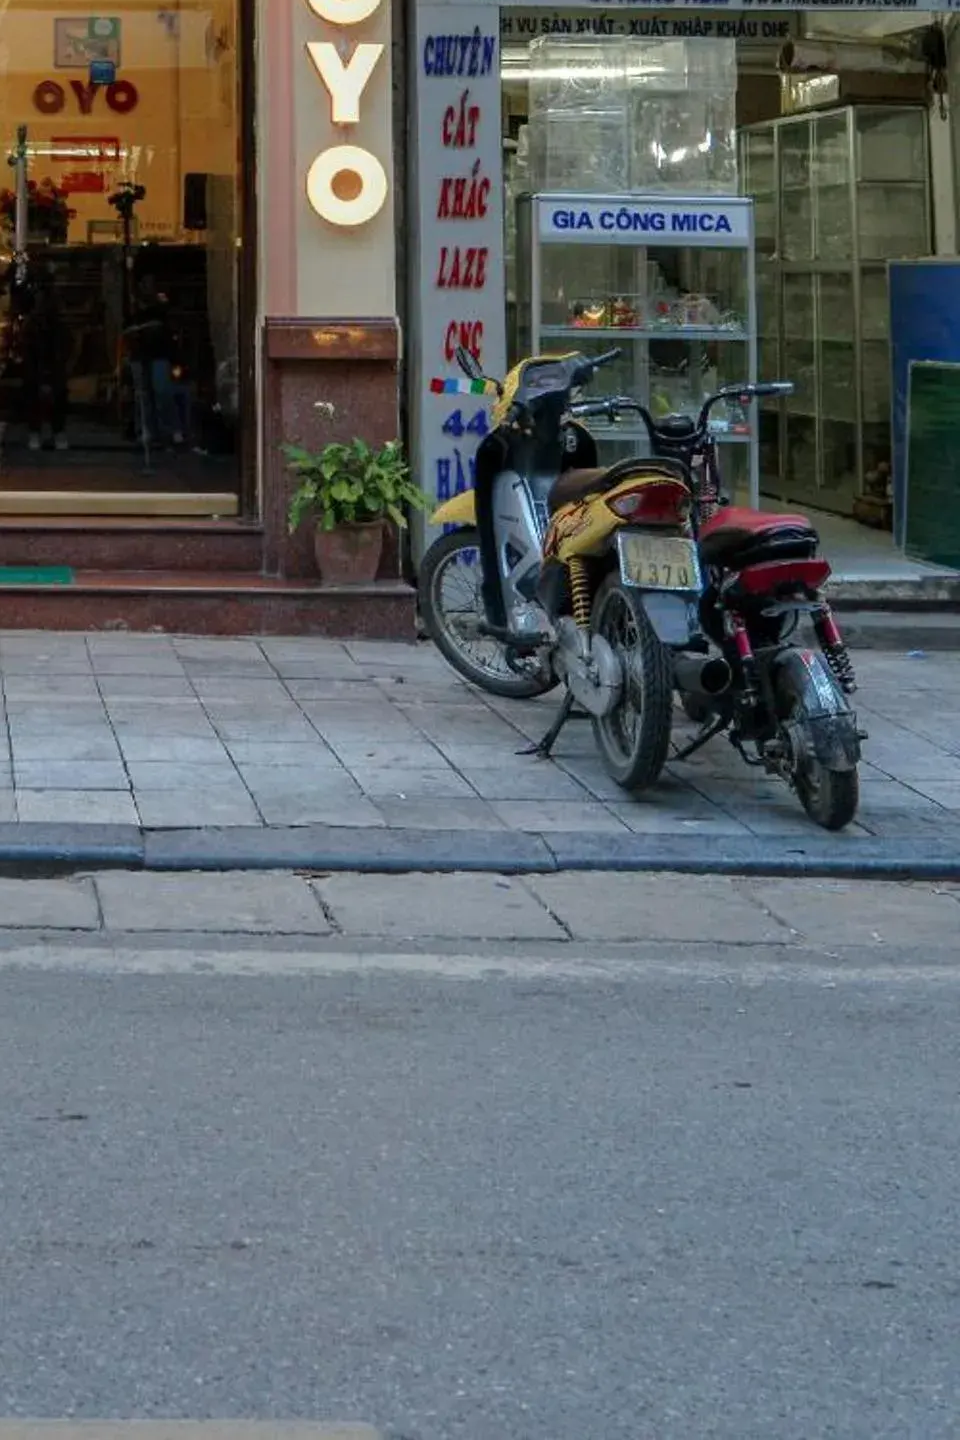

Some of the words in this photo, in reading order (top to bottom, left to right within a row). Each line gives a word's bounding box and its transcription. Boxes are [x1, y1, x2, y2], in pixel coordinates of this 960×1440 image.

[33, 79, 138, 116] OYO
[552, 209, 594, 230] GIA
[599, 207, 665, 232] CÔNG
[671, 213, 733, 233] MICA
[436, 246, 489, 289] LAZE
[444, 320, 484, 362] CNC
[442, 408, 489, 438] 44
